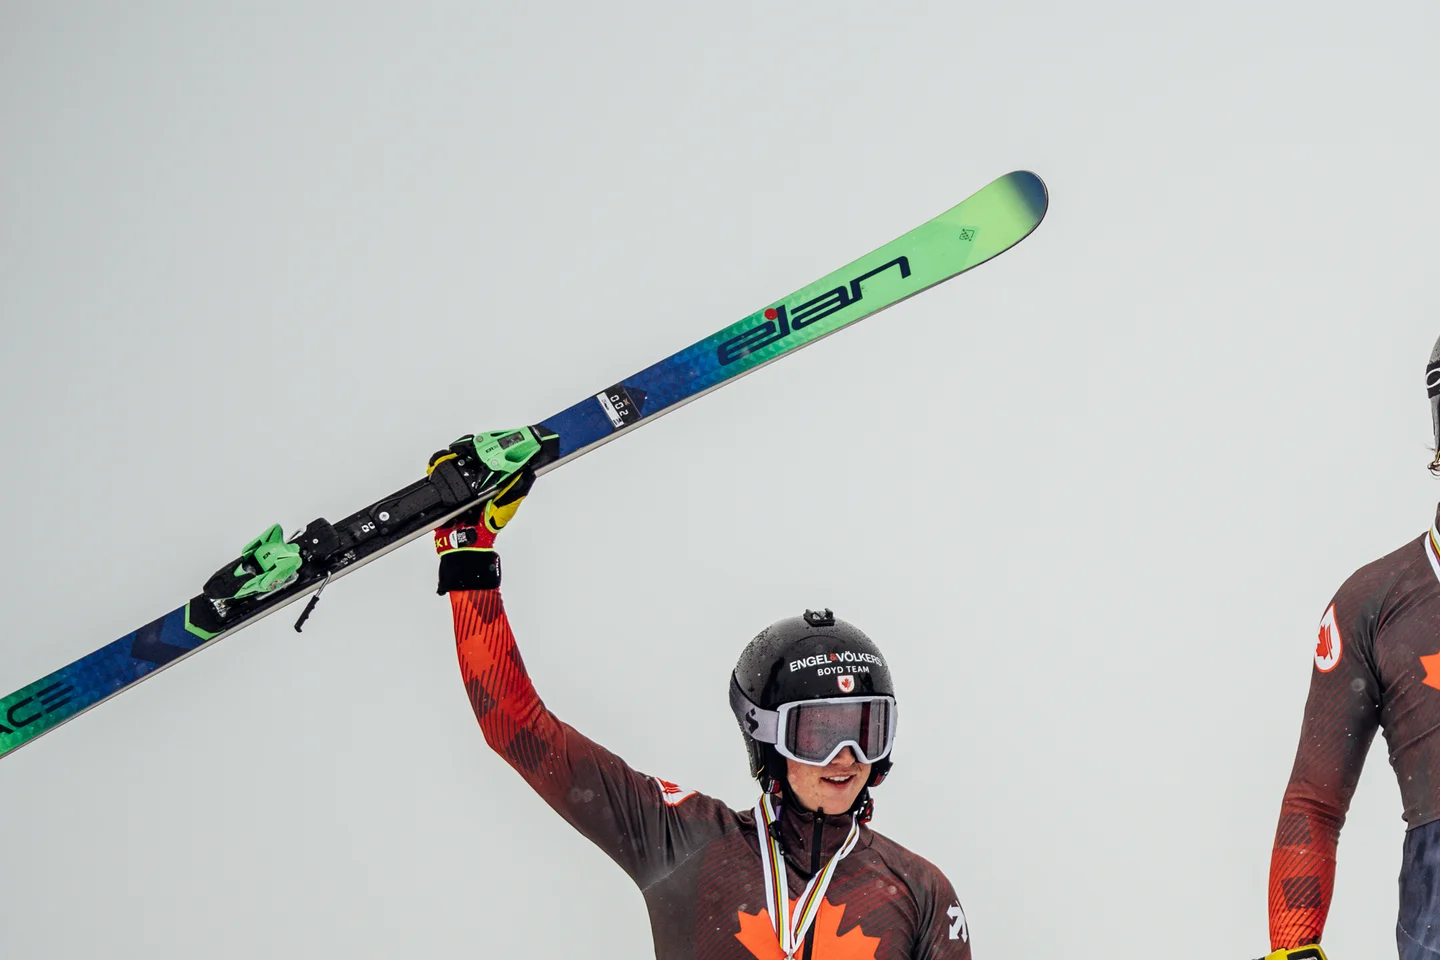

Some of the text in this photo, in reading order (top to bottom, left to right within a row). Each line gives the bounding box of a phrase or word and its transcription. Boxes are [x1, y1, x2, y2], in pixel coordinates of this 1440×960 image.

[717, 255, 912, 367] elan
[610, 394, 629, 417] 002
[817, 665, 870, 677] BOYD TEAM
